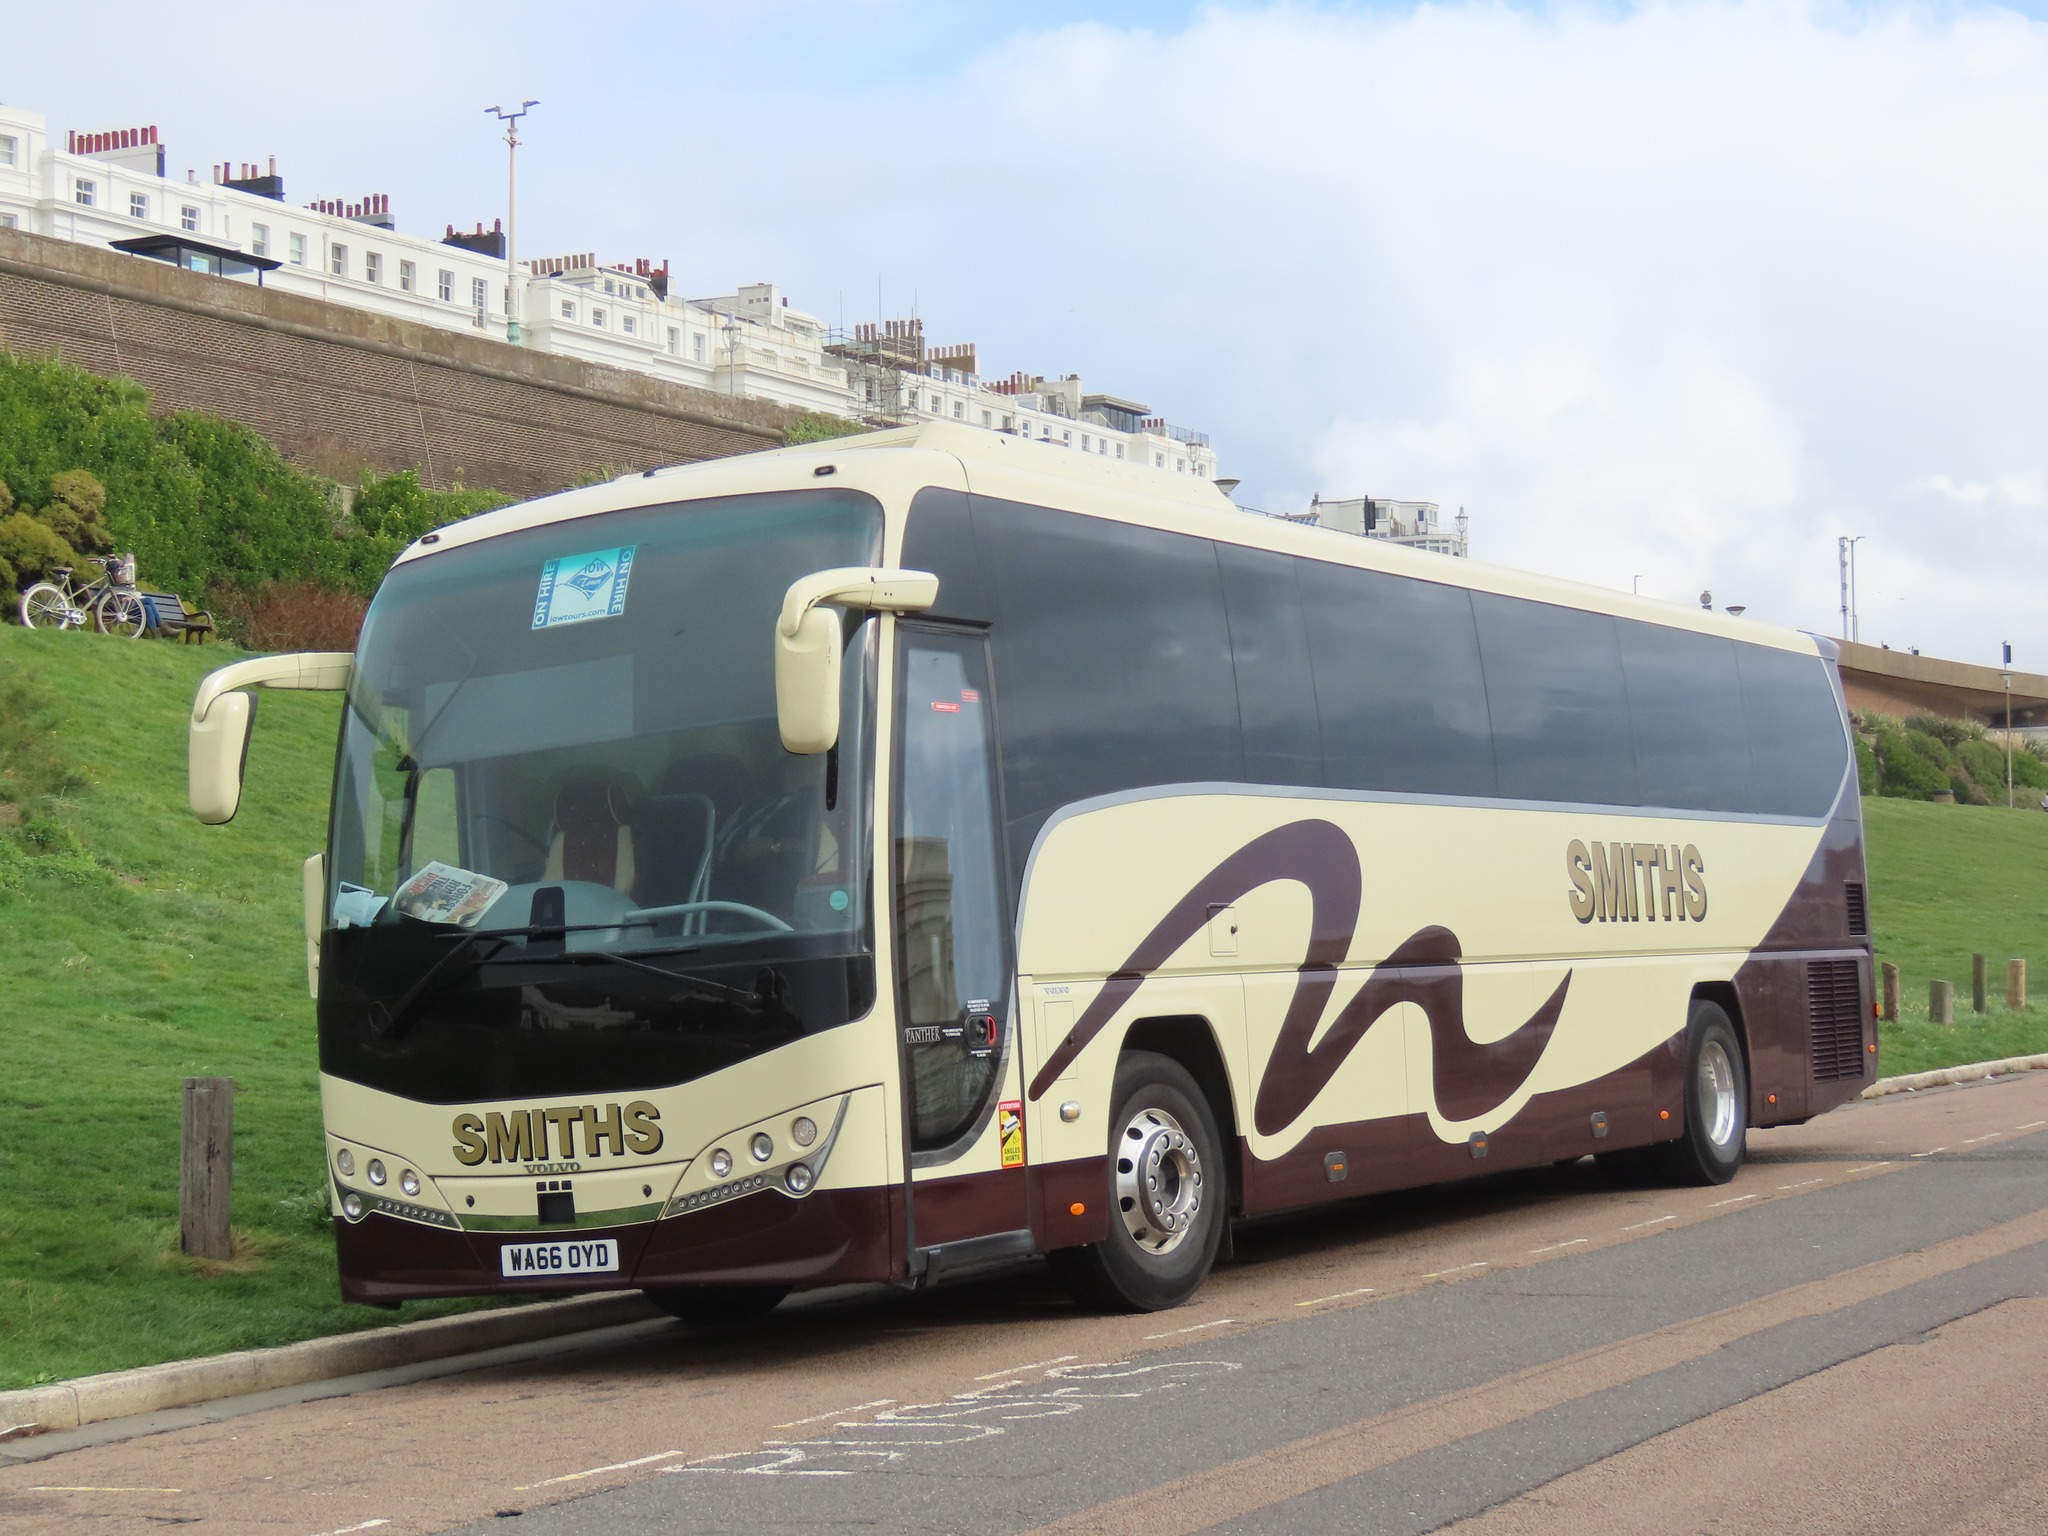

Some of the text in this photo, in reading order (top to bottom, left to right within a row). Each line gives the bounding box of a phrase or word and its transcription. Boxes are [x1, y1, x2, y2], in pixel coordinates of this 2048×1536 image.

[611, 550, 632, 613] ON HIRE
[534, 562, 555, 625] ON HIRE
[550, 608, 606, 622] iowtours.com
[1566, 838, 1708, 925] SMITHS
[905, 1027, 941, 1043] PANTHER
[1000, 1102, 1020, 1110] ATTENTION
[452, 1100, 664, 1166] SMITHS
[1004, 1147, 1021, 1155] ANGLES
[1005, 1154, 1021, 1162] MORTS
[524, 1161, 582, 1175] VOLVO
[510, 1243, 609, 1271] WA66 OYD
